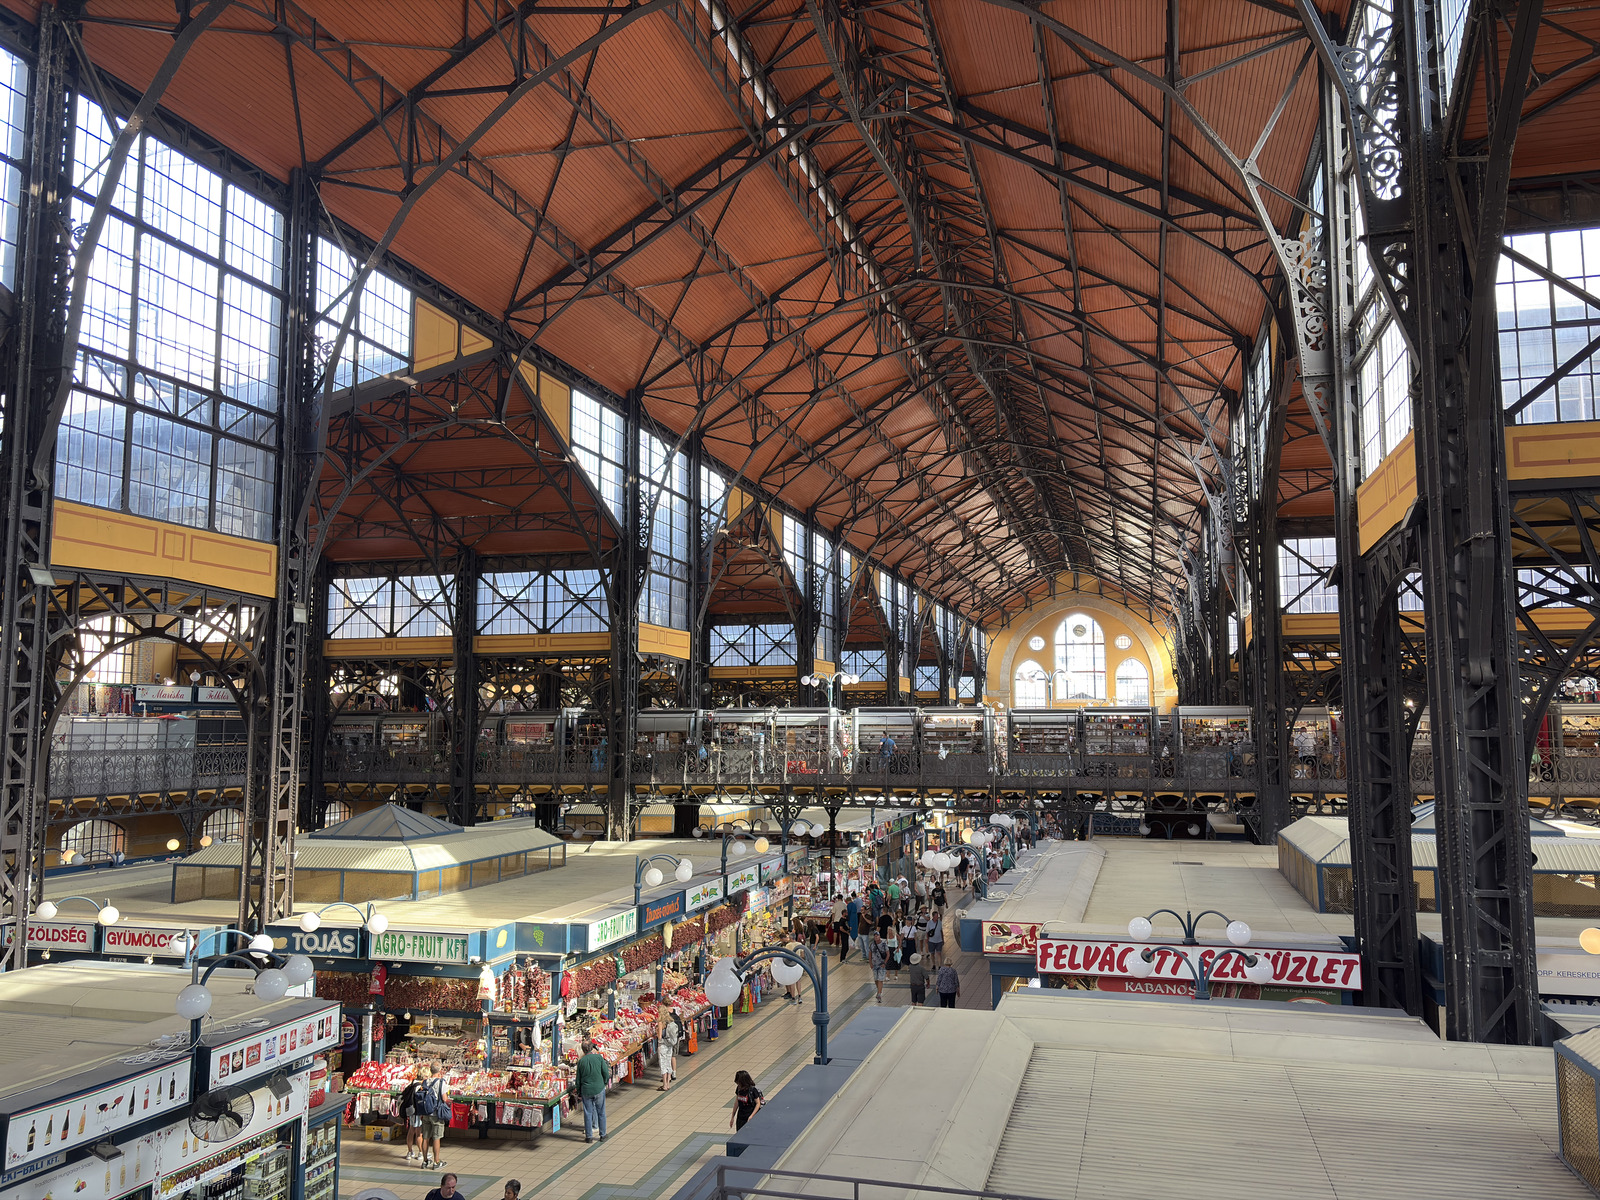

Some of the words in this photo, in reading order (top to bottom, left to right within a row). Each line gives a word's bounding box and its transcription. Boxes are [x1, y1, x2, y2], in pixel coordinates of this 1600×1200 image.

[152, 689, 185, 699] Mariska
[27, 925, 87, 943] ZÖLDSÉG
[291, 930, 356, 954] TOJÁS
[374, 933, 444, 959] AGRO-FRUIT
[446, 938, 468, 960] KFT.
[1039, 942, 1189, 976] FELVÁGTT
[1199, 949, 1359, 986] SZAÜZLET
